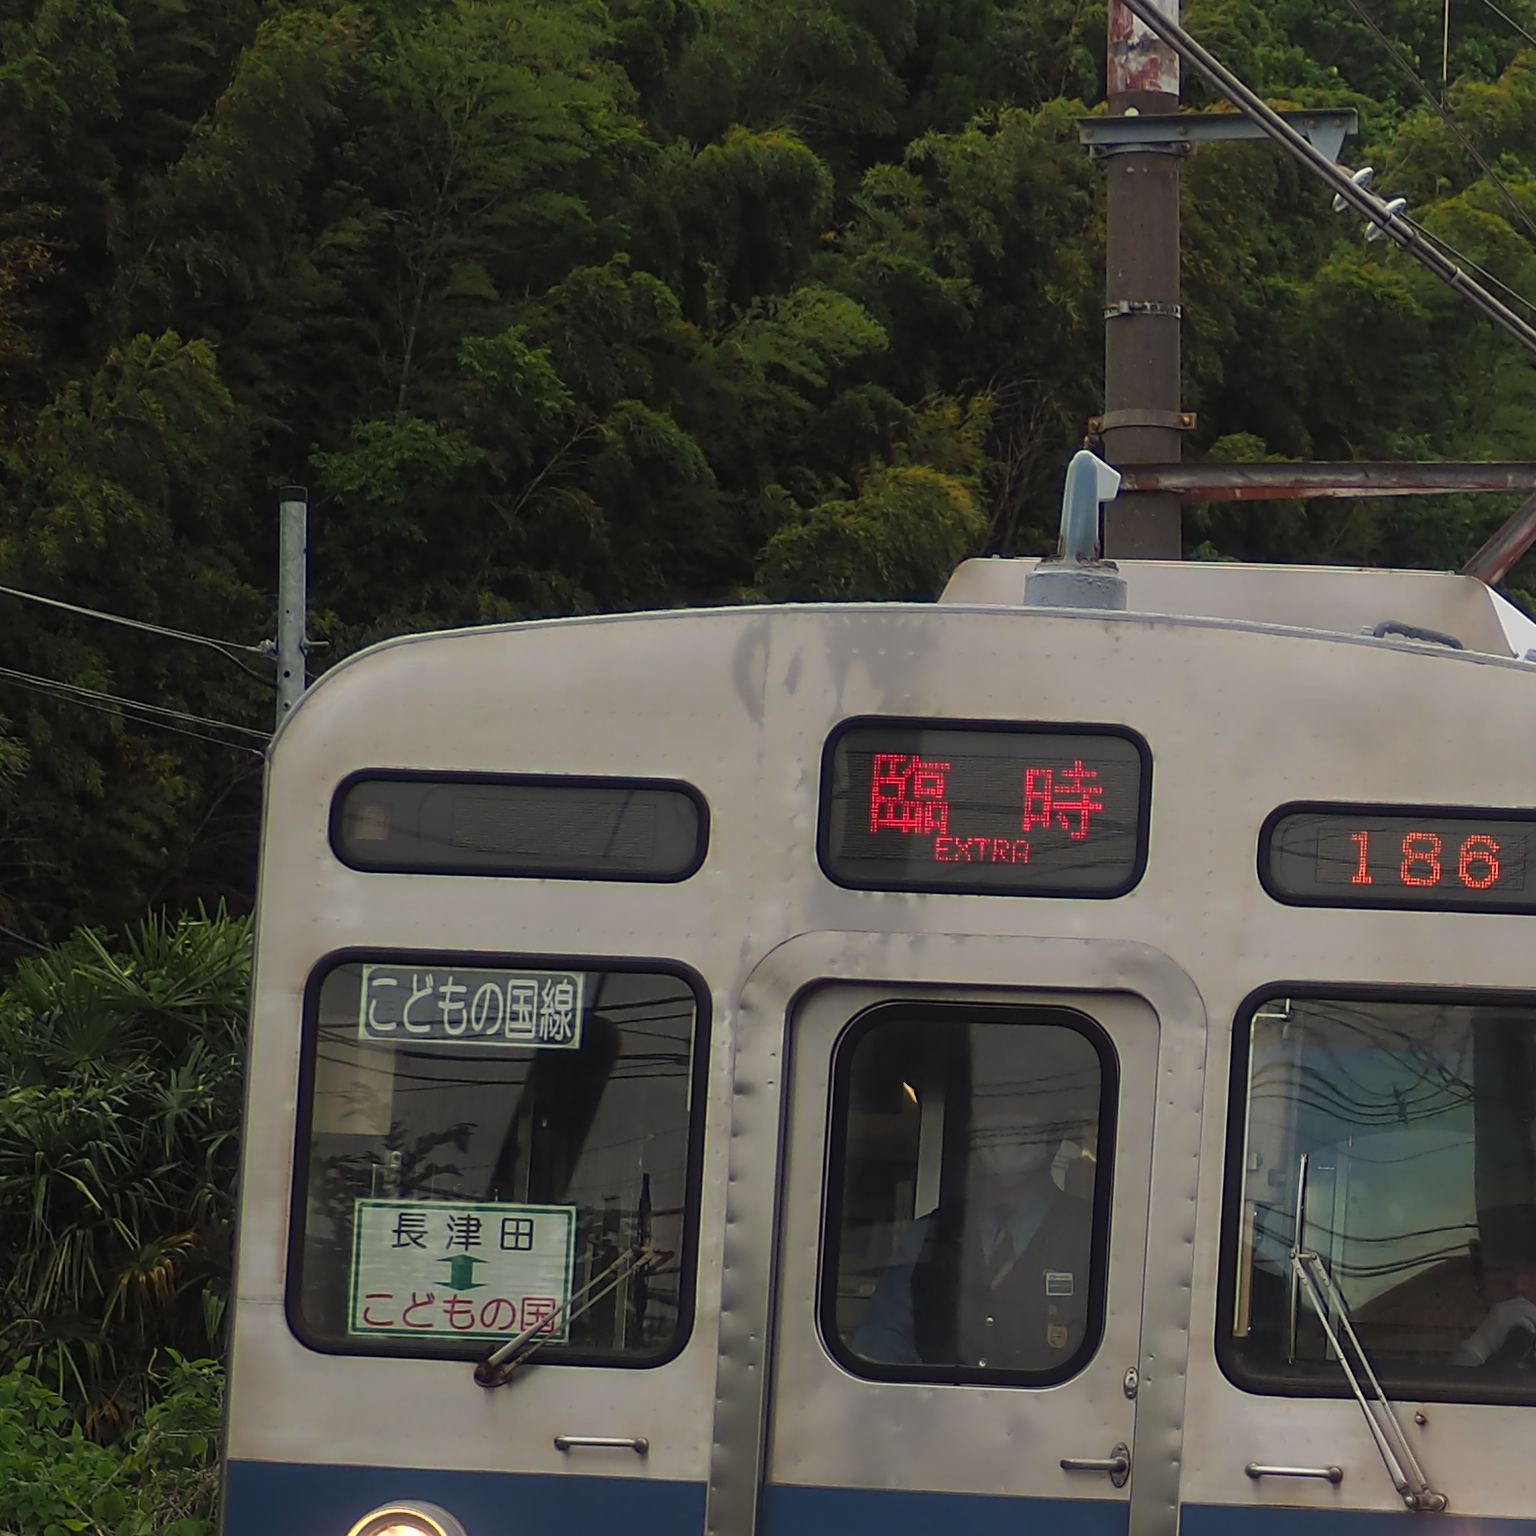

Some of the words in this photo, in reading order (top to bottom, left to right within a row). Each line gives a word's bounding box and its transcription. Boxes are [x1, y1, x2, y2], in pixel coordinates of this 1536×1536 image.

[869, 753, 1103, 840] 臨時
[934, 837, 1031, 865] EXTRA
[1350, 830, 1501, 889] 186
[368, 973, 575, 1041] こどもの国線
[390, 1212, 535, 1252] 長津田
[362, 1291, 557, 1334] こどもの国
